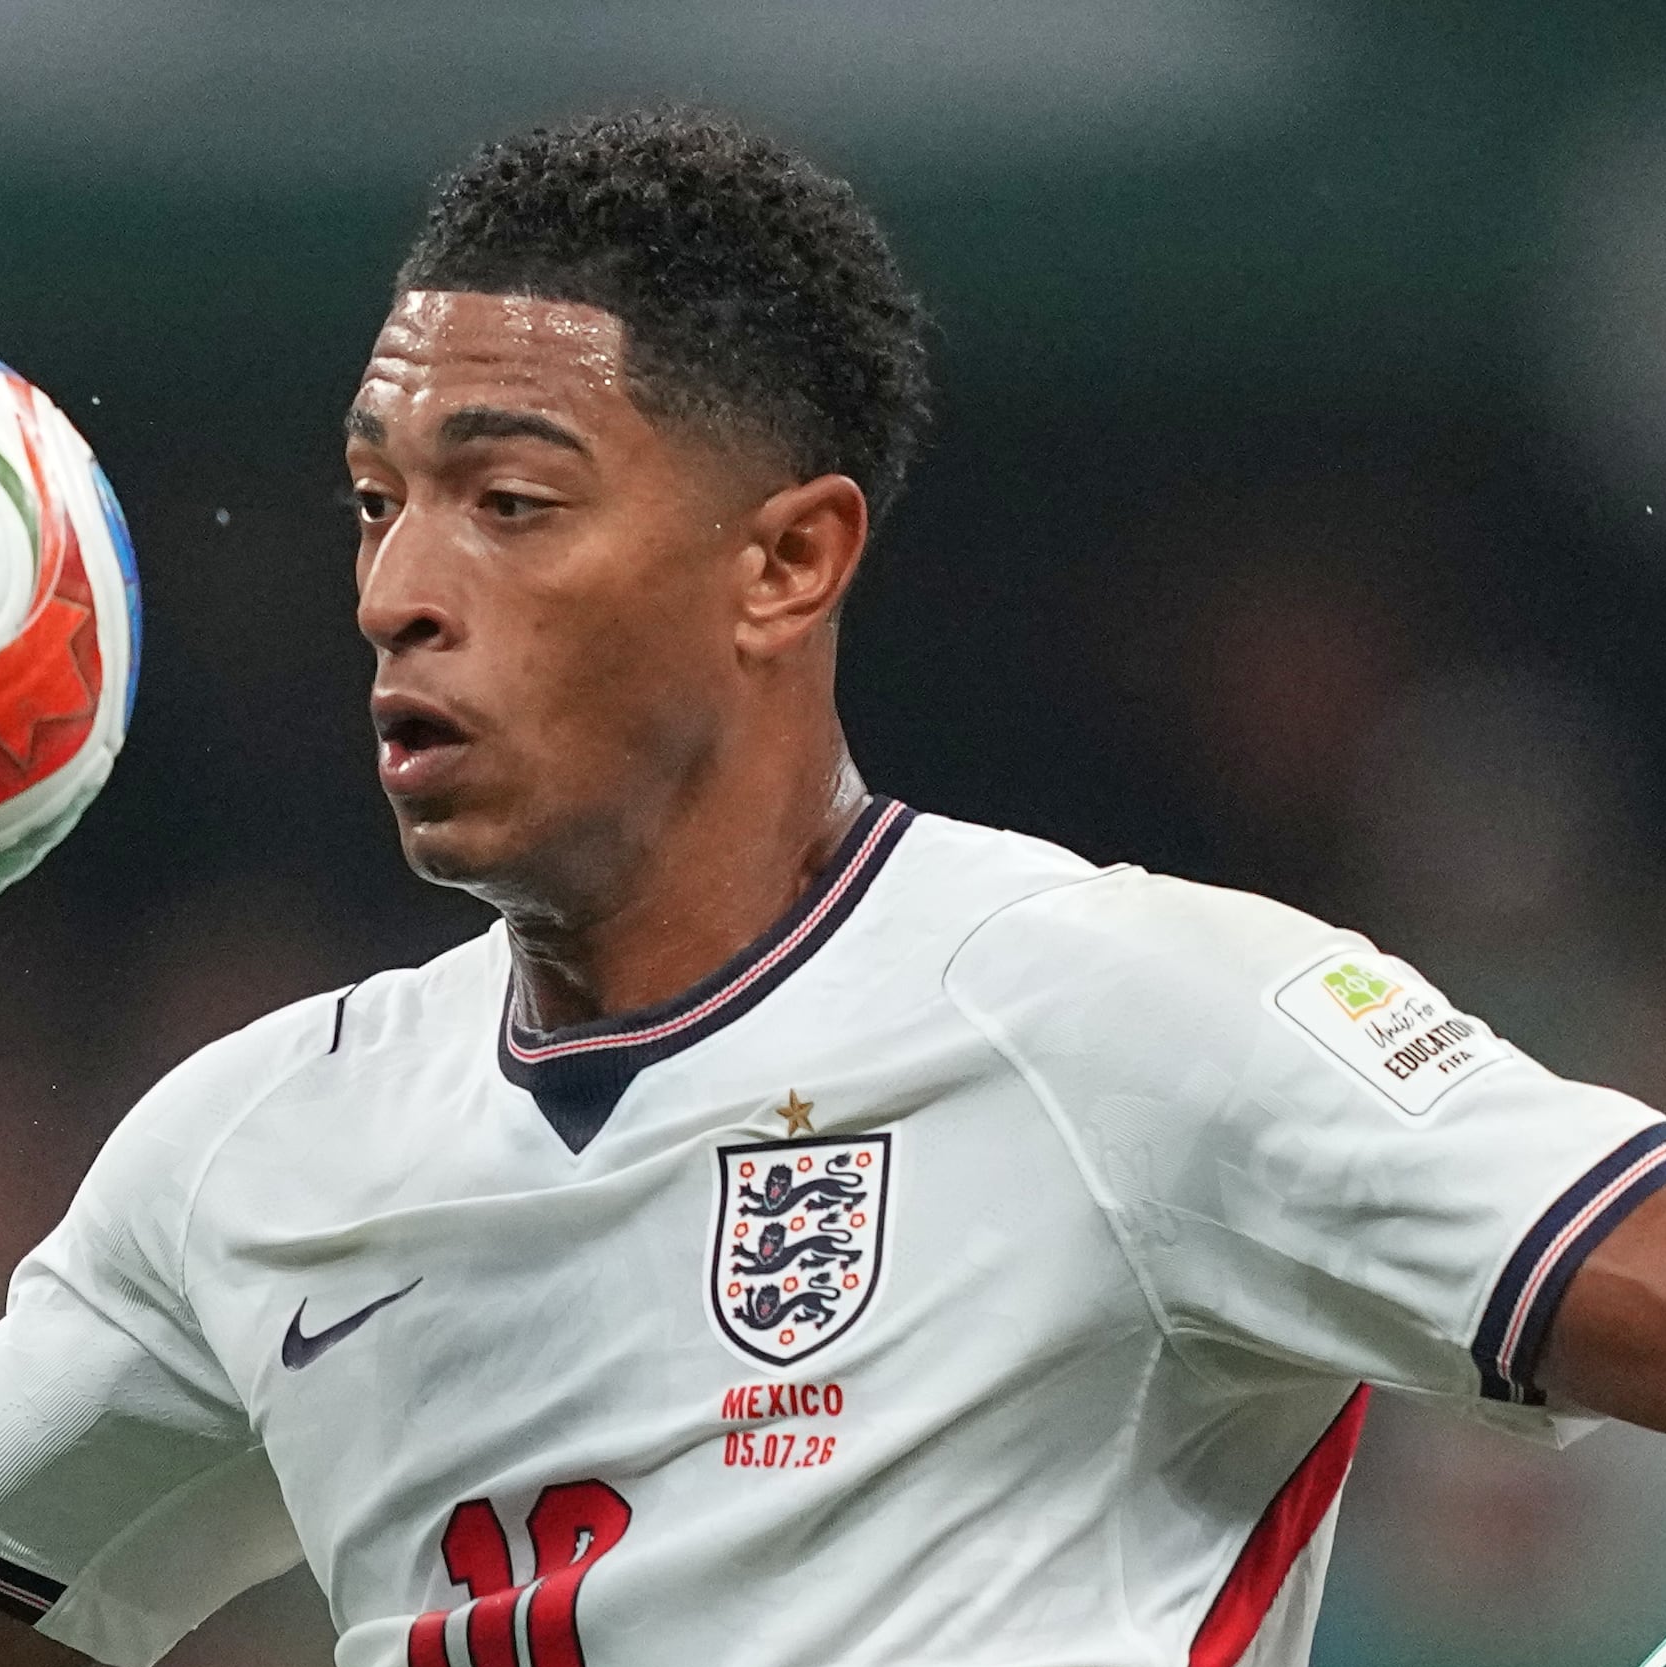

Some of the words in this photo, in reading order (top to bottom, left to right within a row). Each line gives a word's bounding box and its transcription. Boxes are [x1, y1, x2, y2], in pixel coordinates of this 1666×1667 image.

[1365, 1010, 1415, 1049] Unite
[1404, 997, 1436, 1023] For
[1383, 1018, 1475, 1081] EDUCATION
[1437, 1050, 1475, 1075] FIFA
[721, 1383, 844, 1420] MEXICO
[723, 1430, 836, 1469] 05.07.26
